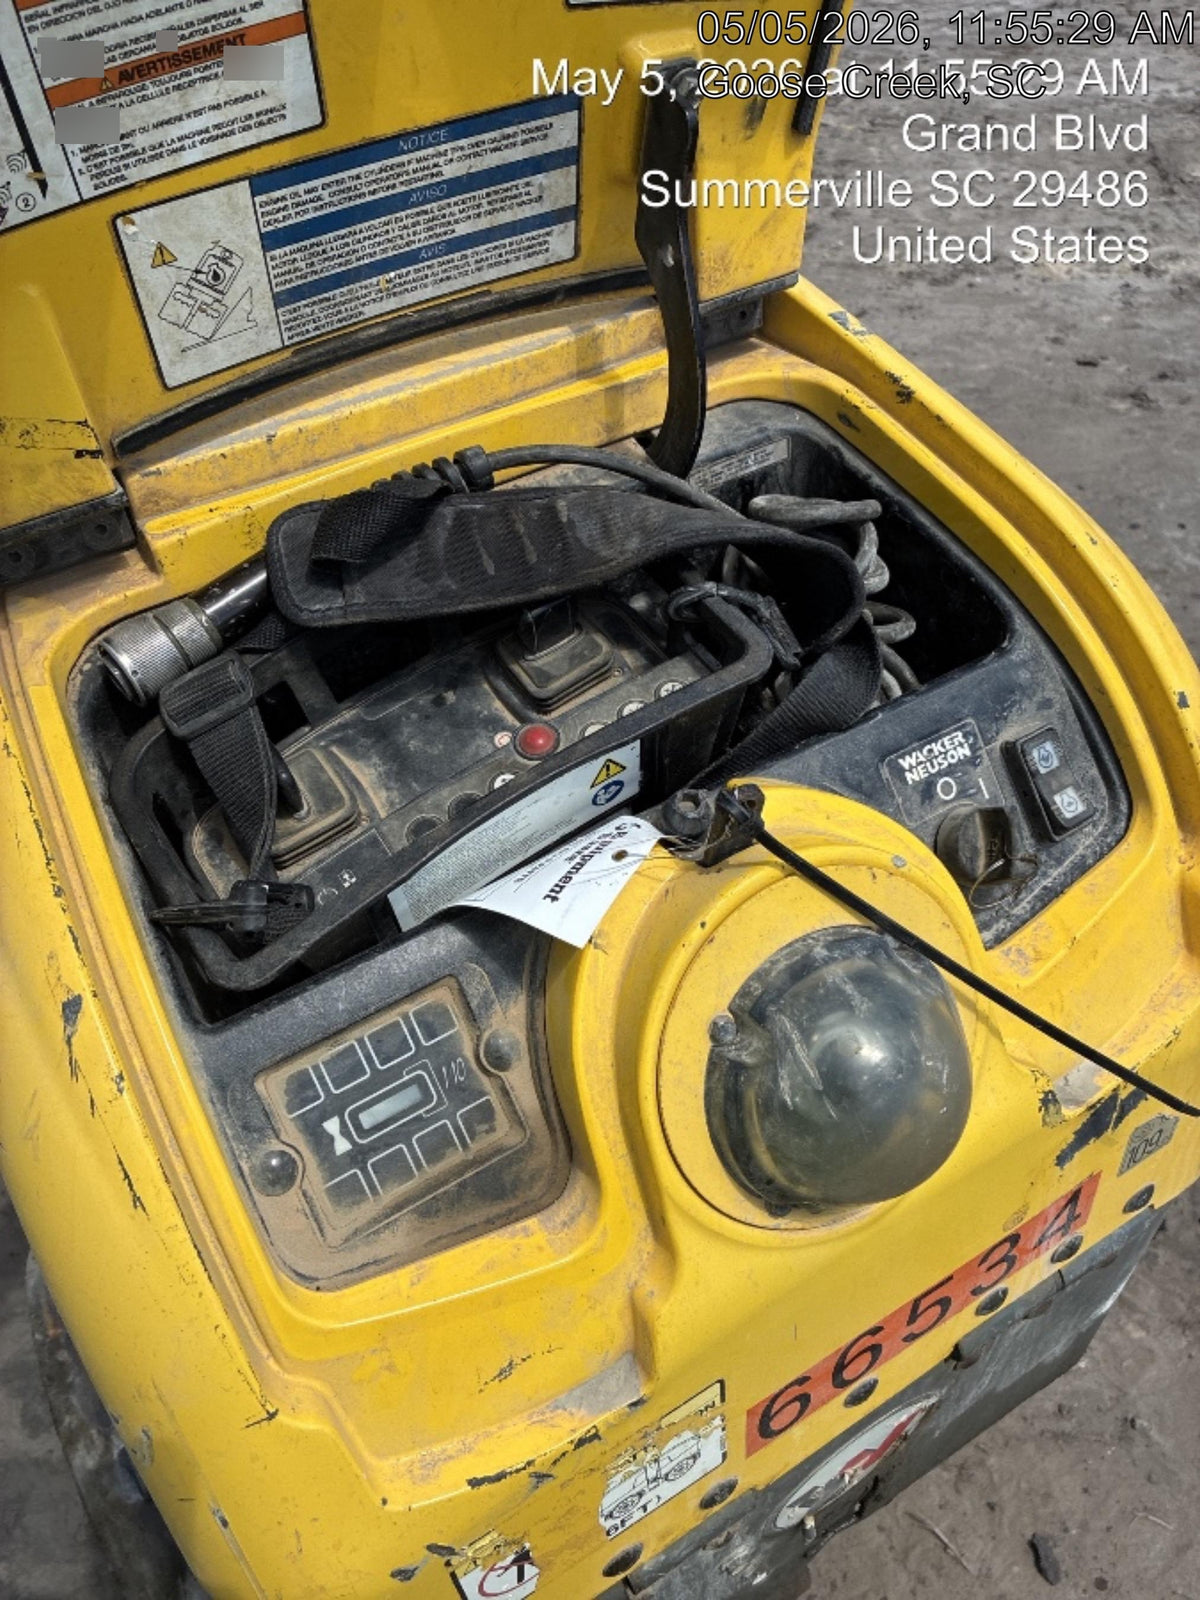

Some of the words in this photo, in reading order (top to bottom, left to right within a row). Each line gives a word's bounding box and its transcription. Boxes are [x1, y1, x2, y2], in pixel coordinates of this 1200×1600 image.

[117, 33, 247, 83] AVERTISSEMENT
[399, 129, 449, 151] NOTICE
[898, 730, 966, 771] WACKER
[904, 744, 971, 785] NEUSON
[757, 1185, 1084, 1440] 66534
